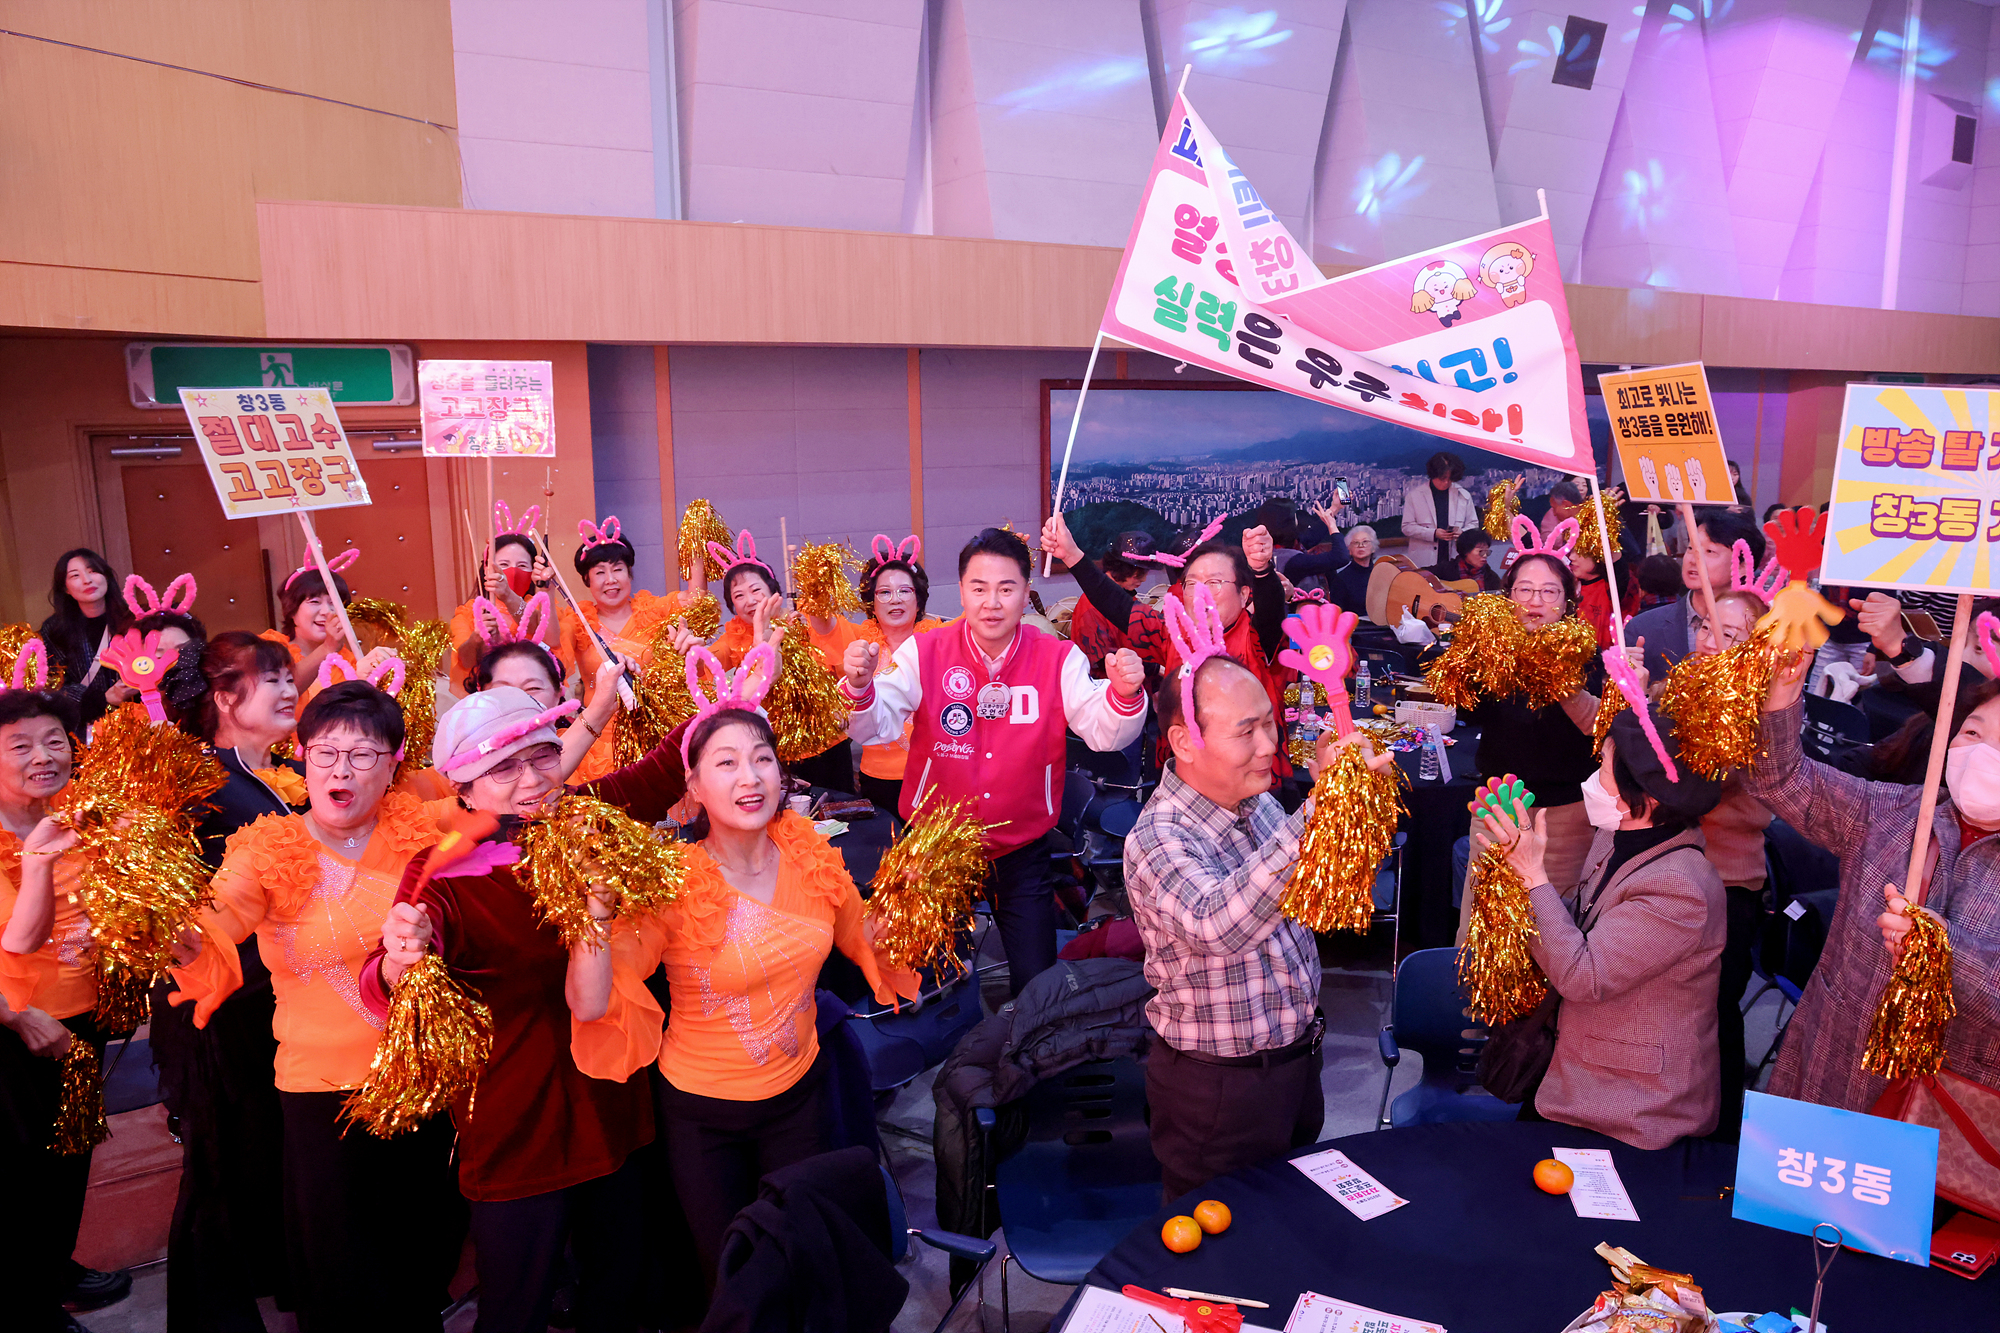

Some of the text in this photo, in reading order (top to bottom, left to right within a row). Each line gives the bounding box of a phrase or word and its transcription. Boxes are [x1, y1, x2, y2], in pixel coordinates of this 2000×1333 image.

[1153, 275, 1283, 370] 실력은
[1388, 337, 1518, 393] 고!
[236, 393, 287, 412] 창3동
[1617, 381, 1698, 410] 최고로 빛나는
[198, 413, 341, 456] 절대고수
[1617, 411, 1714, 438] 창3동을 응원해!
[1861, 427, 1935, 468] 방송
[1941, 431, 1985, 471] 탈
[219, 455, 357, 502] 고고장구
[1870, 493, 1982, 542] 창3동
[1010, 685, 1039, 724] D
[1777, 1147, 1892, 1206] 창3동
